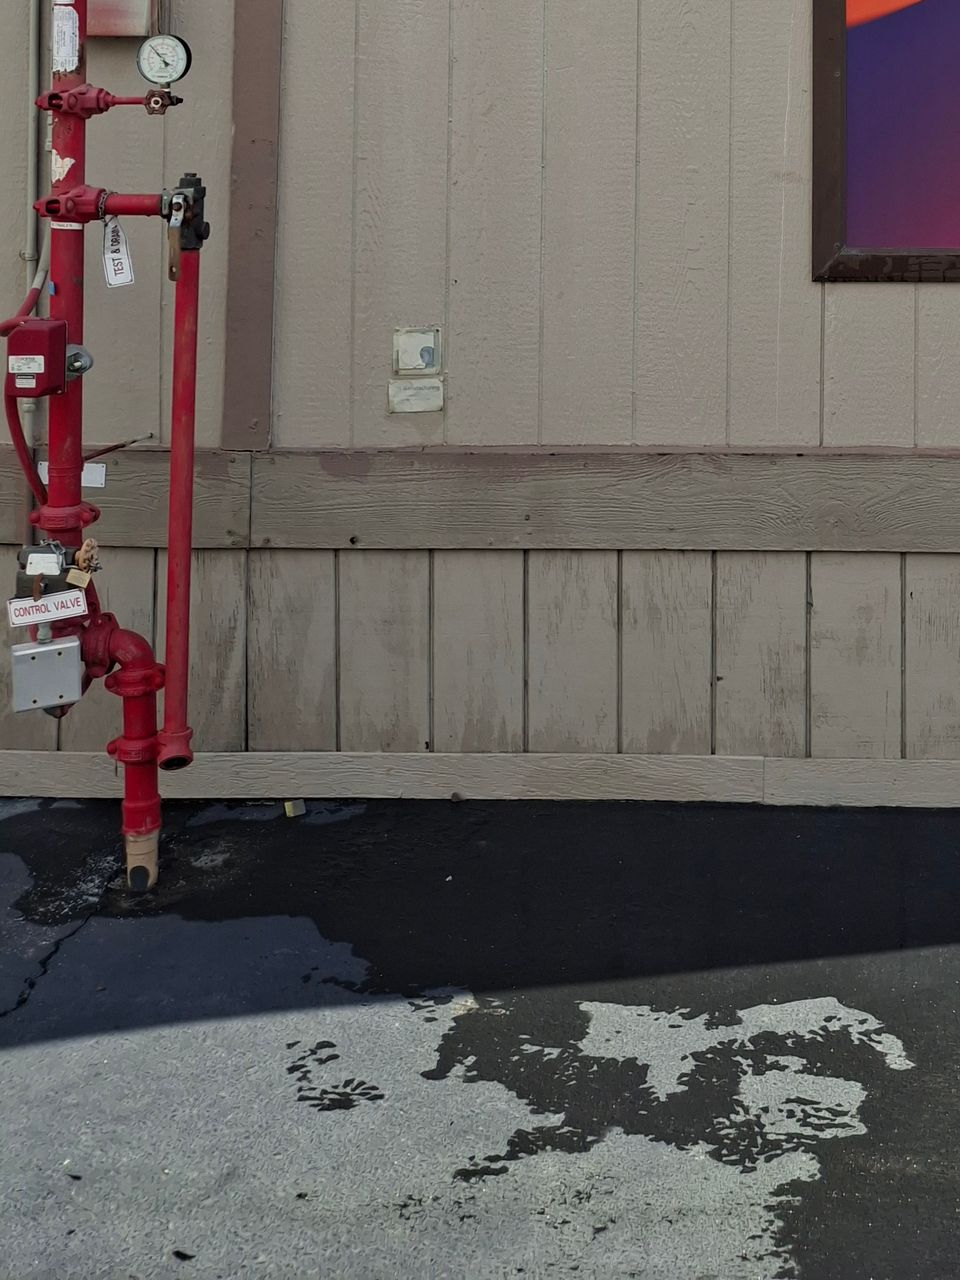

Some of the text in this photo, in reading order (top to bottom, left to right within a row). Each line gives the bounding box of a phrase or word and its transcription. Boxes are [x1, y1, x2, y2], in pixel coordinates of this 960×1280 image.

[110, 247, 121, 255] &
[112, 257, 125, 277] TEST
[13, 596, 81, 617] CONTROL VALVE
